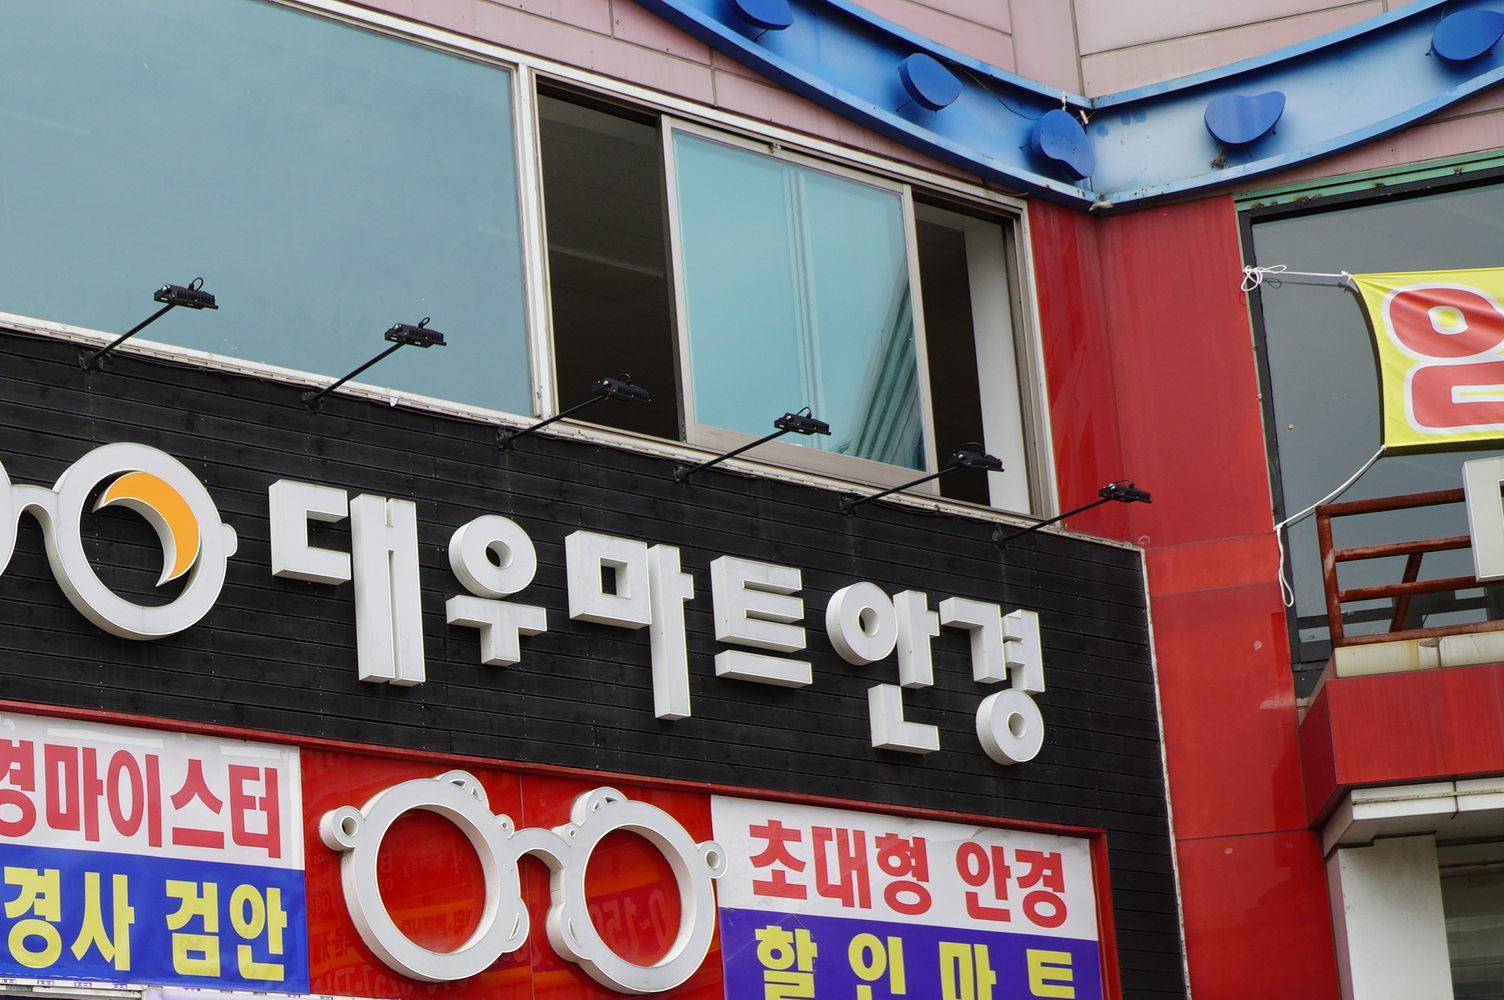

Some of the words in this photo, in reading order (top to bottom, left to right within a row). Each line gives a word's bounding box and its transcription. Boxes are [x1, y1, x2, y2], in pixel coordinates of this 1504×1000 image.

[748, 819, 933, 916] 초대형
[956, 841, 1068, 929] 안경
[165, 878, 288, 982] 검안
